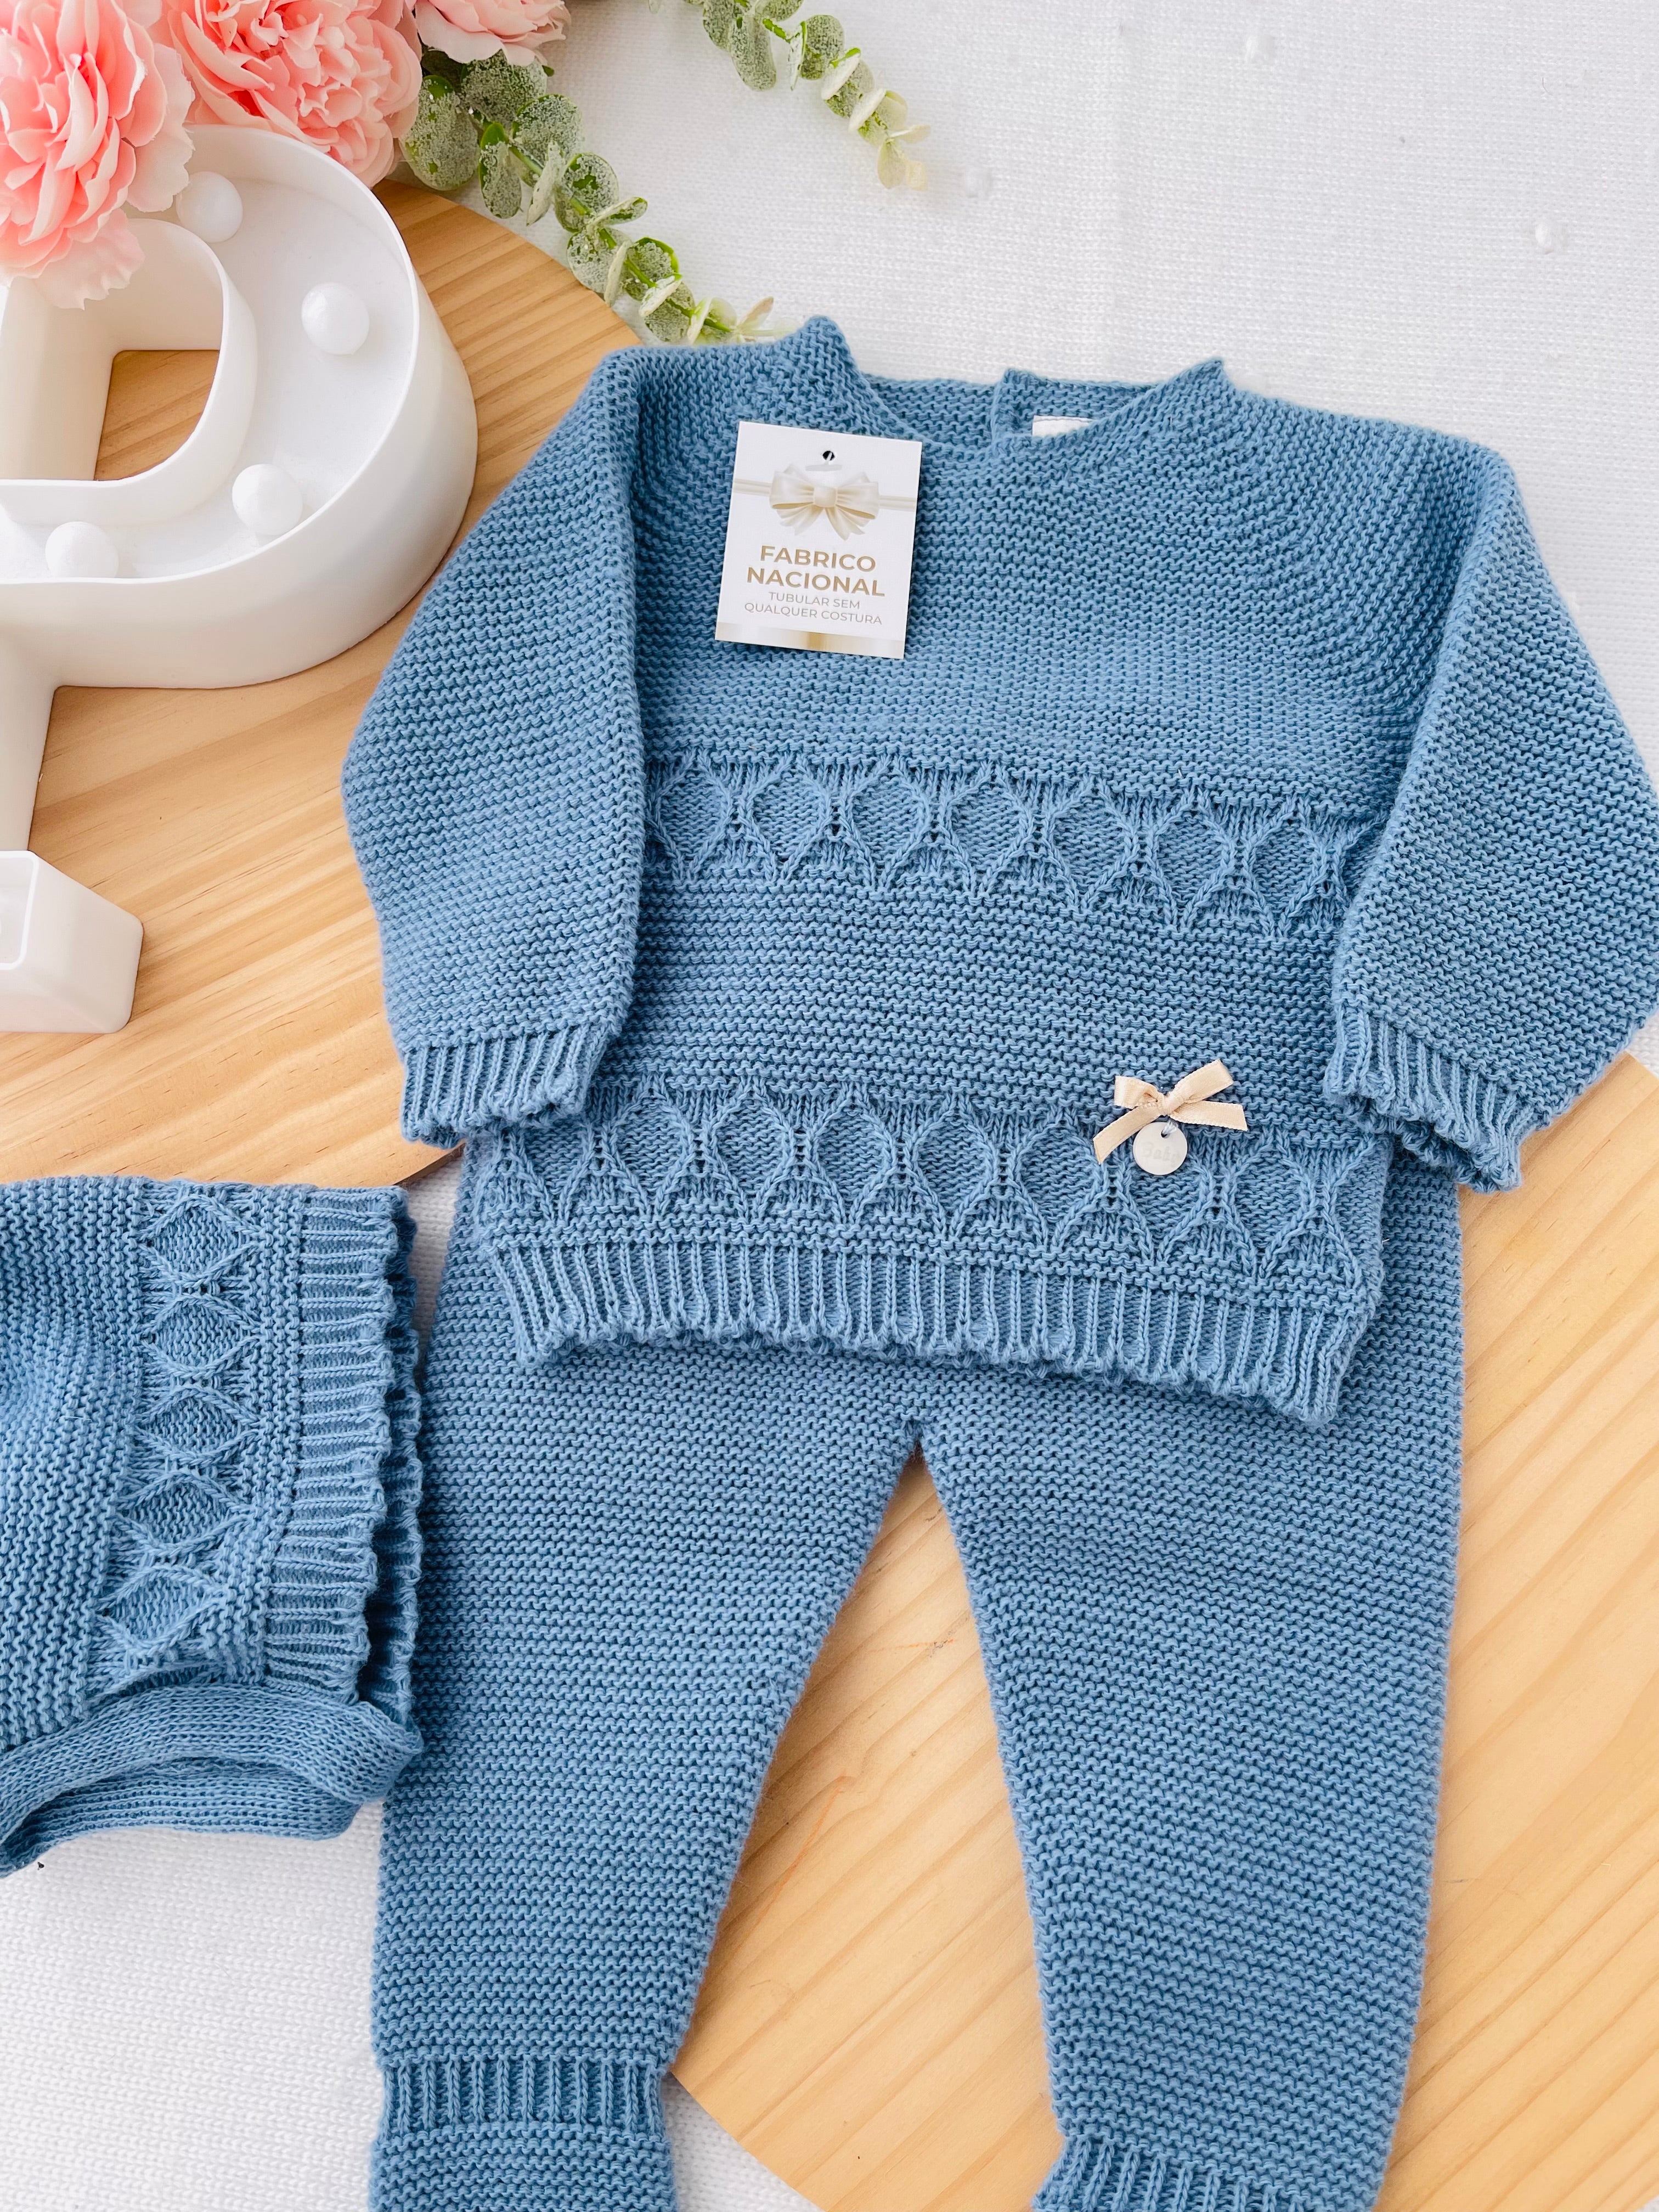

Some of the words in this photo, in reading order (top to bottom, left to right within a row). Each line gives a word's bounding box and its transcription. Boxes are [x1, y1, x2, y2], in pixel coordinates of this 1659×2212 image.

[760, 545, 876, 572] FABRICO
[747, 567, 885, 597] NACIONAL
[768, 591, 829, 606] TUBULAR
[833, 599, 860, 610] SEM
[744, 602, 818, 618] QUALQUER
[821, 610, 883, 625] COSTURA
